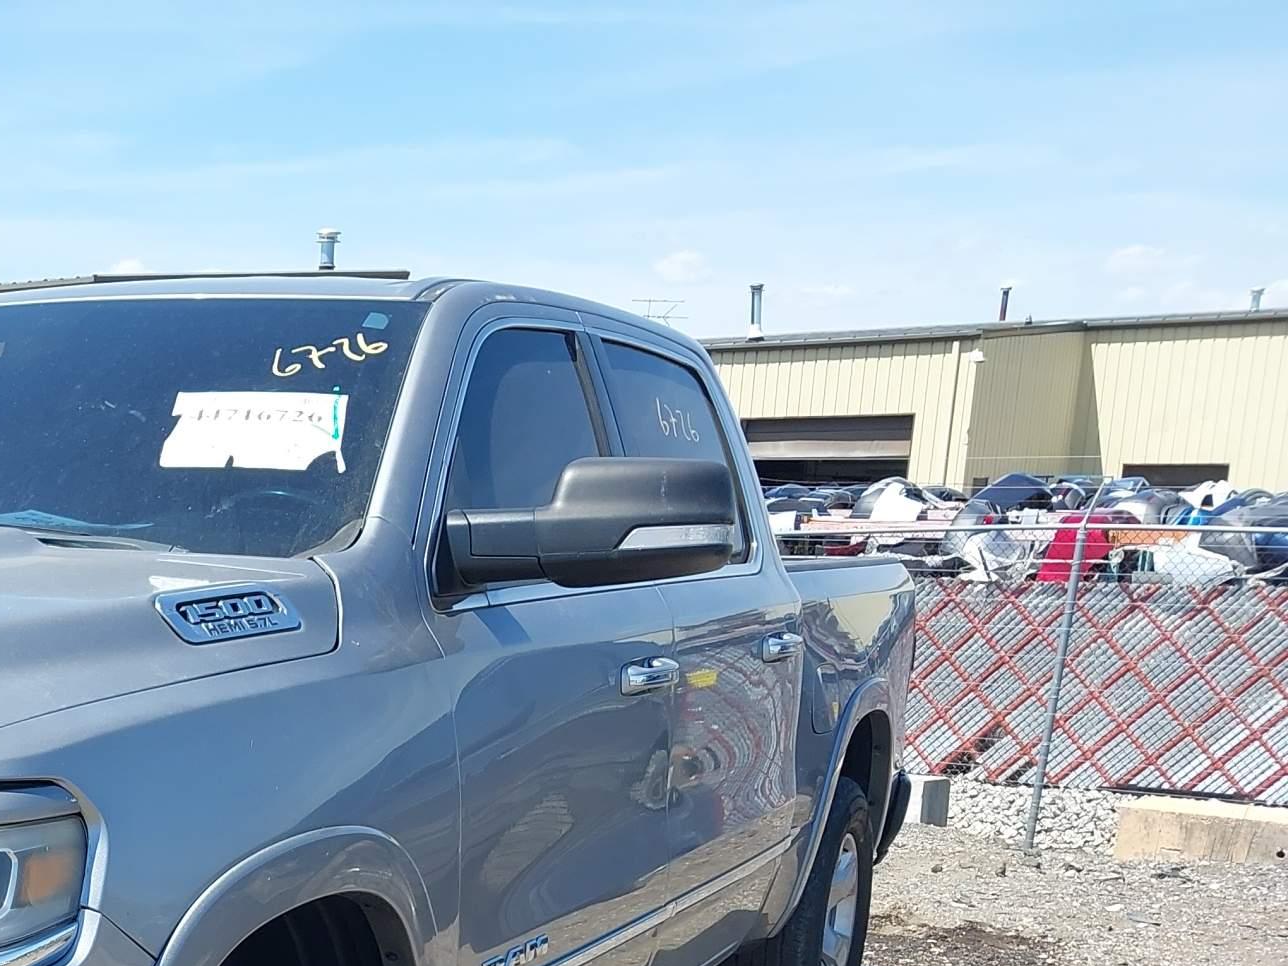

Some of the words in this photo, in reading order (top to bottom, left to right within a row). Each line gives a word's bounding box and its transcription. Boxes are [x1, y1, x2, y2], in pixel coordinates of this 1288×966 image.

[655, 397, 700, 442] 6726
[180, 594, 275, 624] 1500
[203, 620, 245, 637] HEMI
[247, 616, 279, 631] 5.7L
